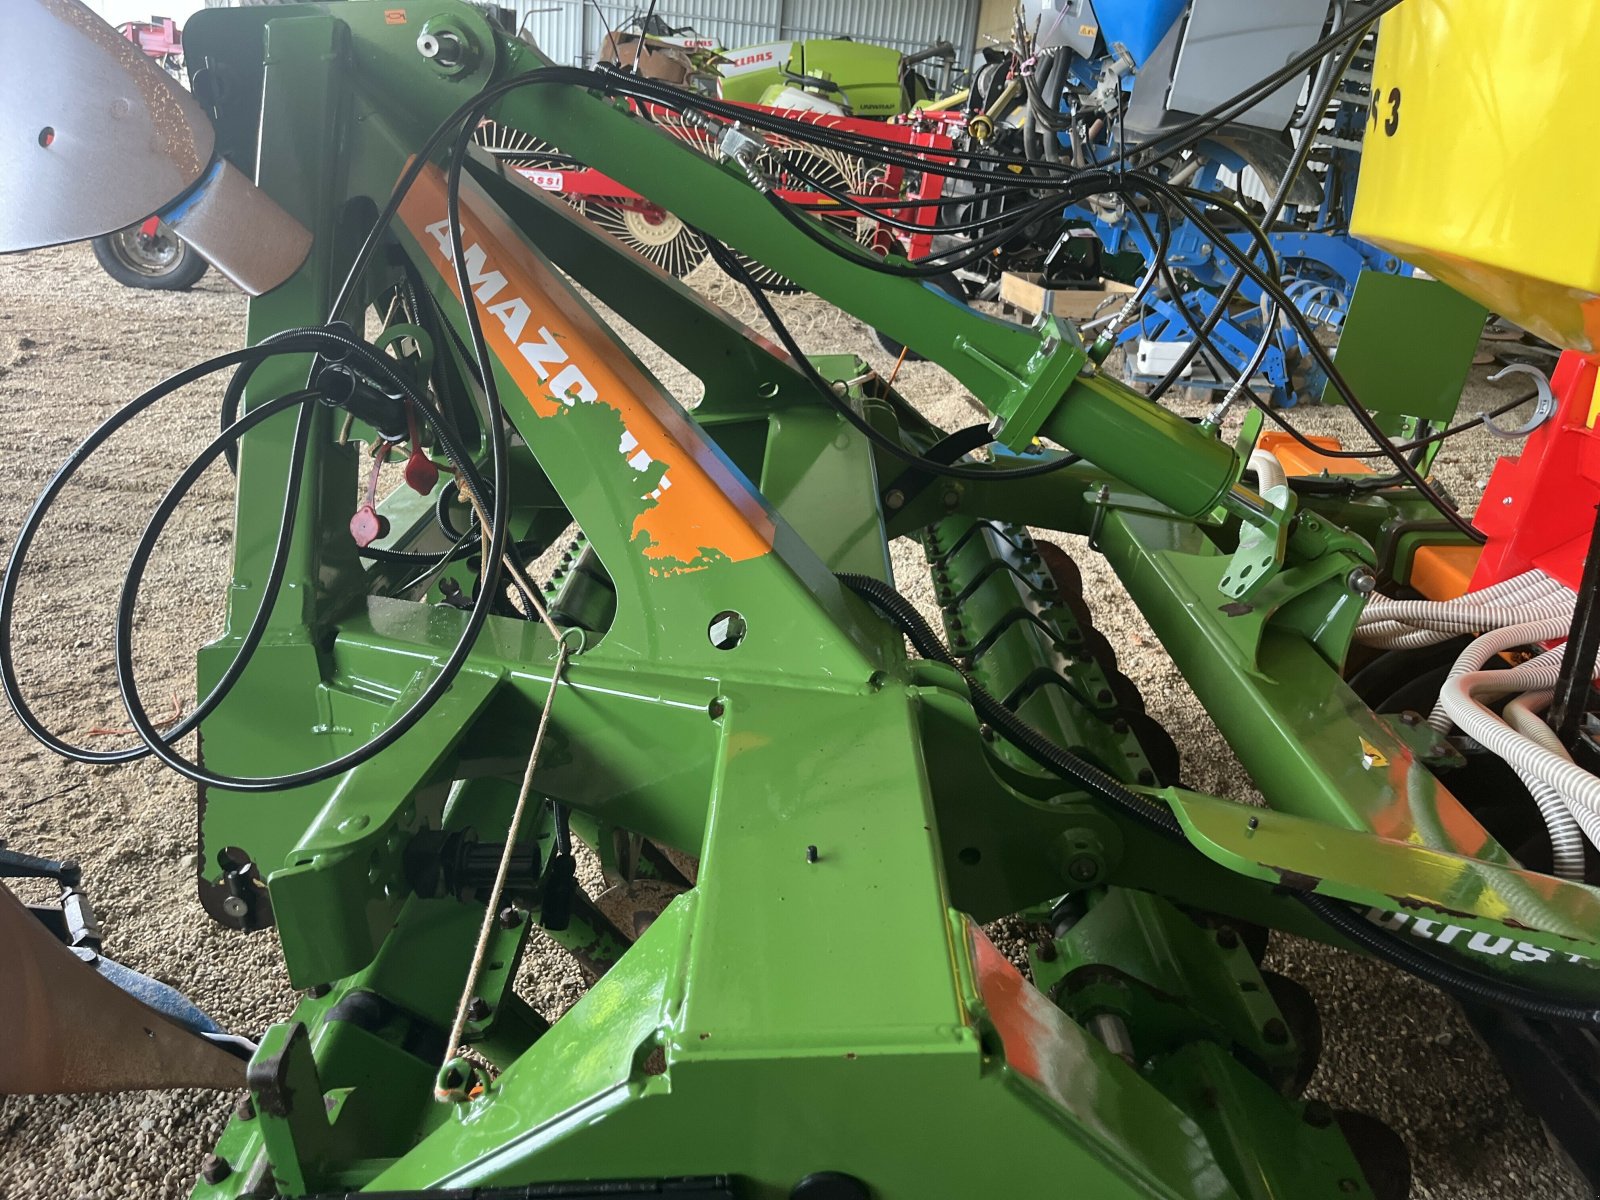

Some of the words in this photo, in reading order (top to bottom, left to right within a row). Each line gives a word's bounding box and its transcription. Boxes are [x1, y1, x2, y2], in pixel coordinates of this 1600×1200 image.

[734, 51, 773, 67] CLAAS
[1384, 87, 1401, 138] 3
[527, 175, 560, 186] OSSI
